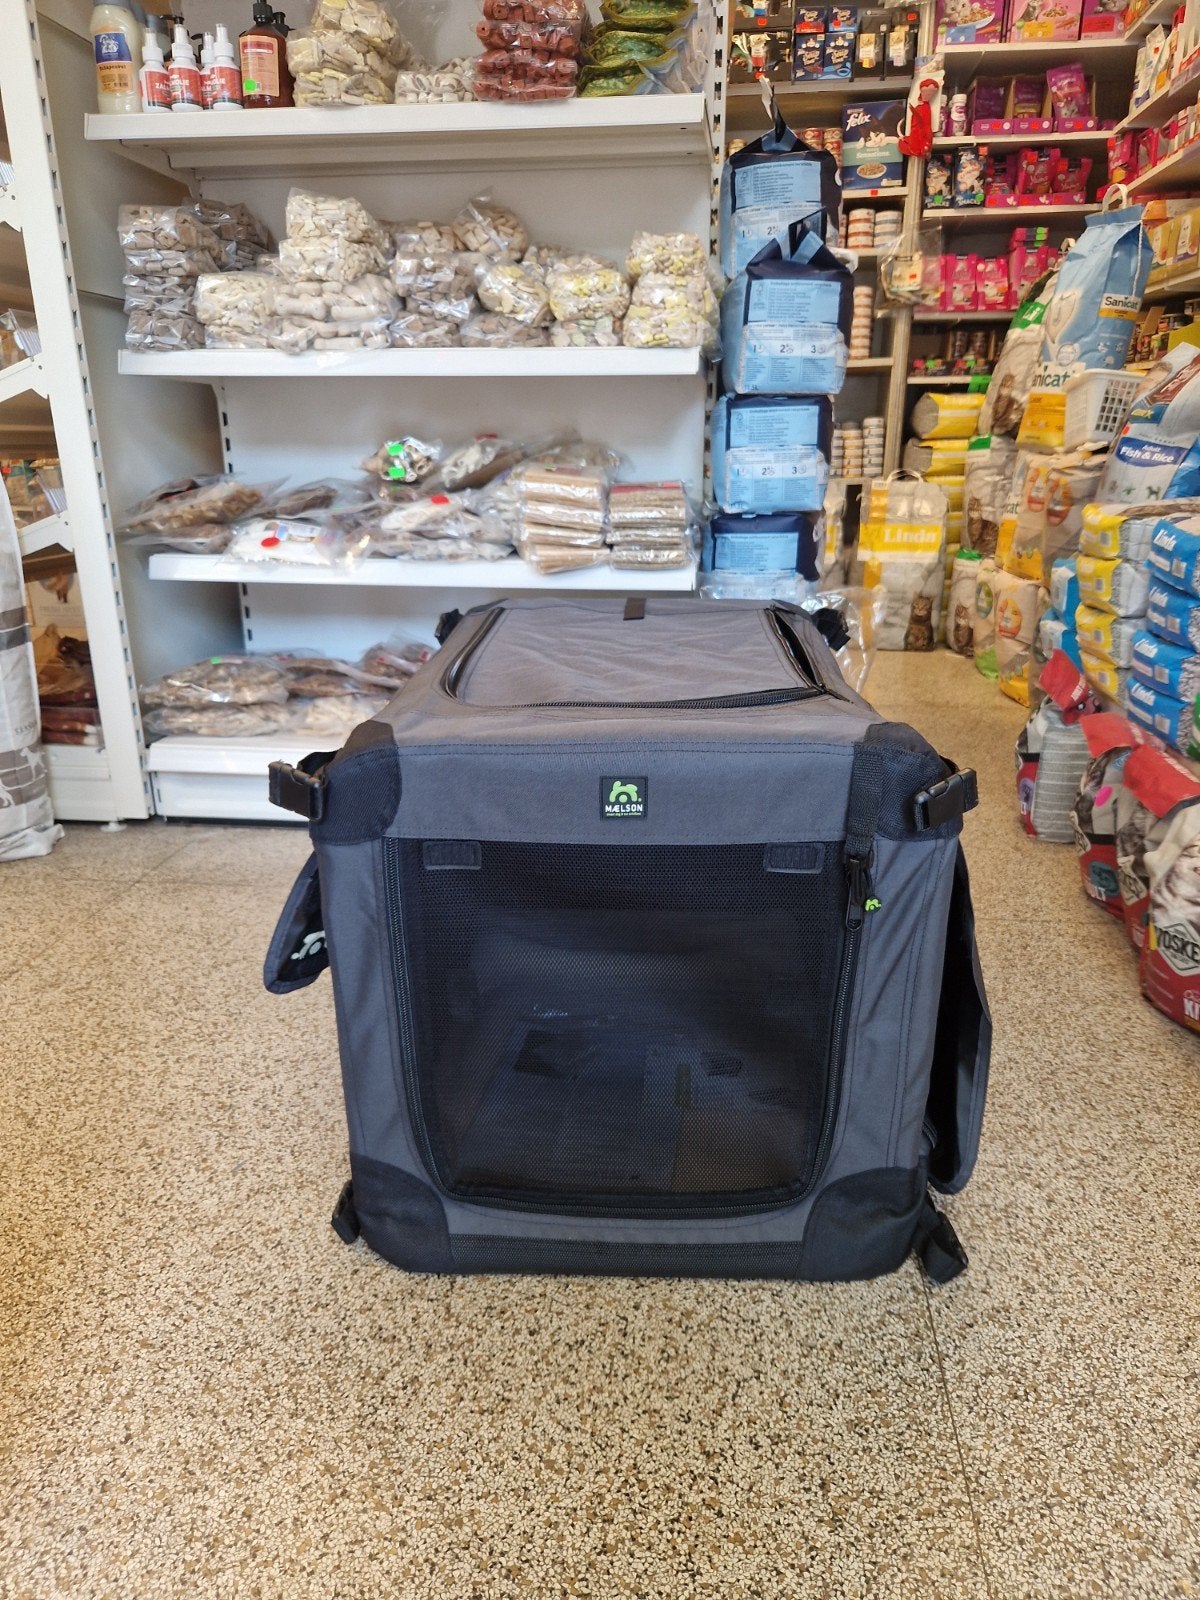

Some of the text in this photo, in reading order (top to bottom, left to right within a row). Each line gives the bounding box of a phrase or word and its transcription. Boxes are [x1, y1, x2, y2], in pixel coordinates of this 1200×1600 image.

[1105, 296, 1138, 309] Sanicat
[1032, 366, 1070, 387] nicat
[1120, 446, 1175, 463] Fish & Rice
[605, 804, 643, 813] MÆLSON
